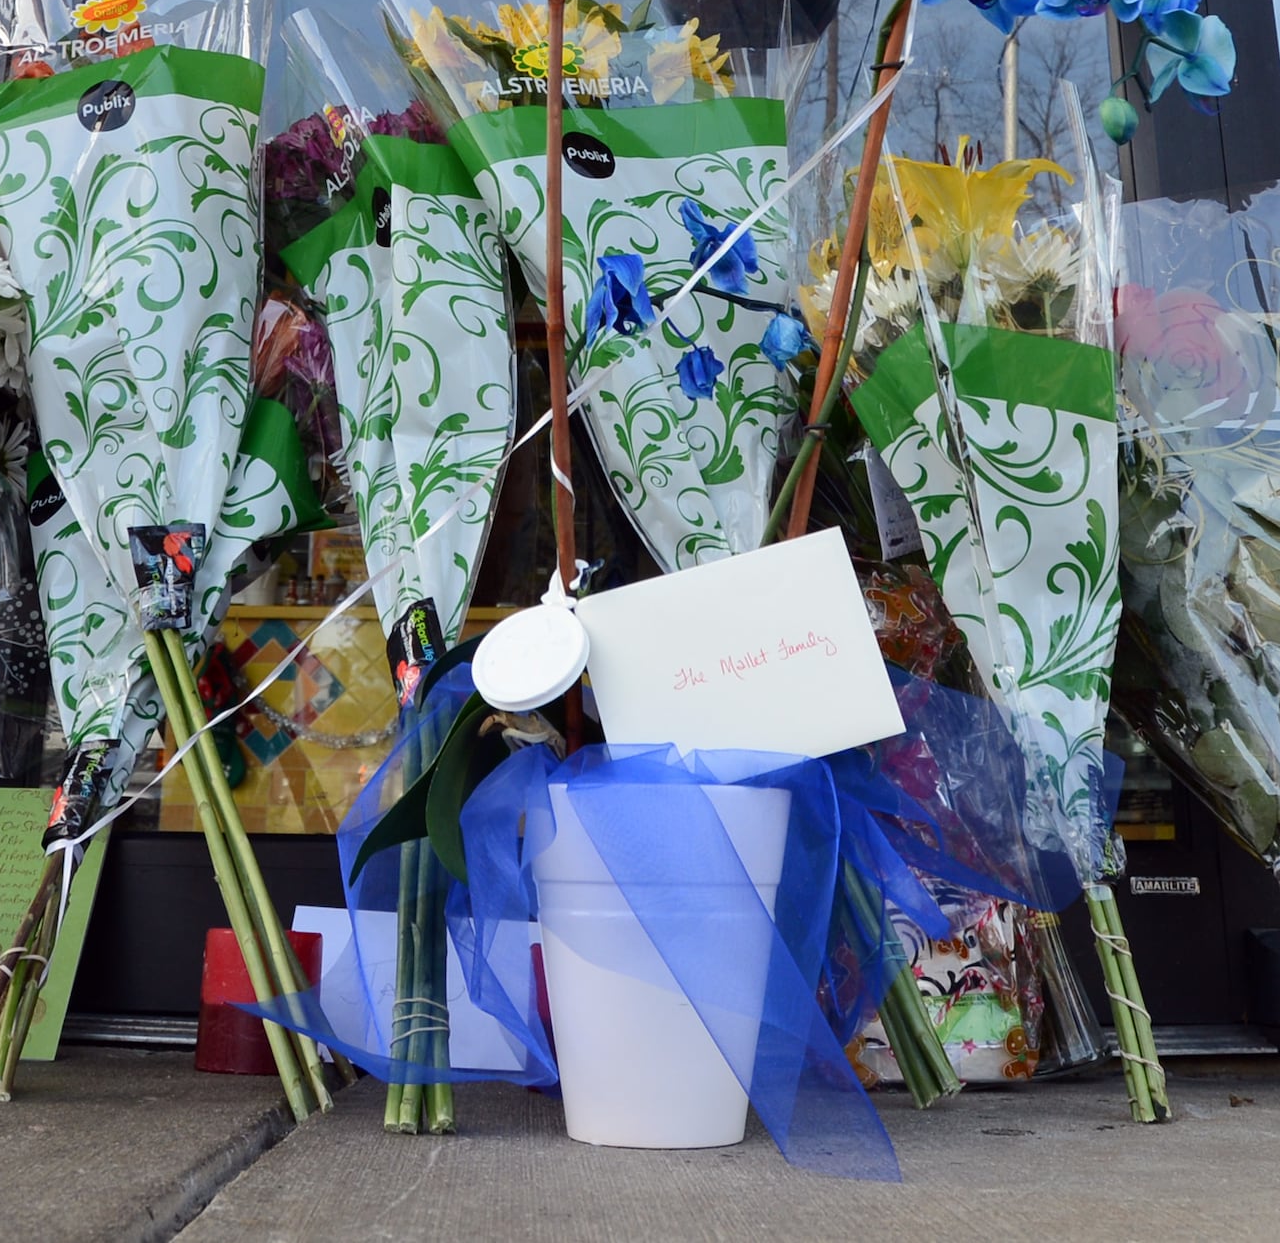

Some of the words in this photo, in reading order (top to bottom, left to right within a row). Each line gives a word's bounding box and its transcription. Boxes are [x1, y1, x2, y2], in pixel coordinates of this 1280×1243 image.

[18, 20, 189, 67] ALSTROEMERIA
[481, 75, 650, 97] ALSTREMERIA
[82, 94, 131, 118] Publix
[566, 146, 611, 164] Publix
[673, 667, 708, 691] The
[778, 631, 838, 661] Family
[1135, 880, 1196, 892] AMARLITE
